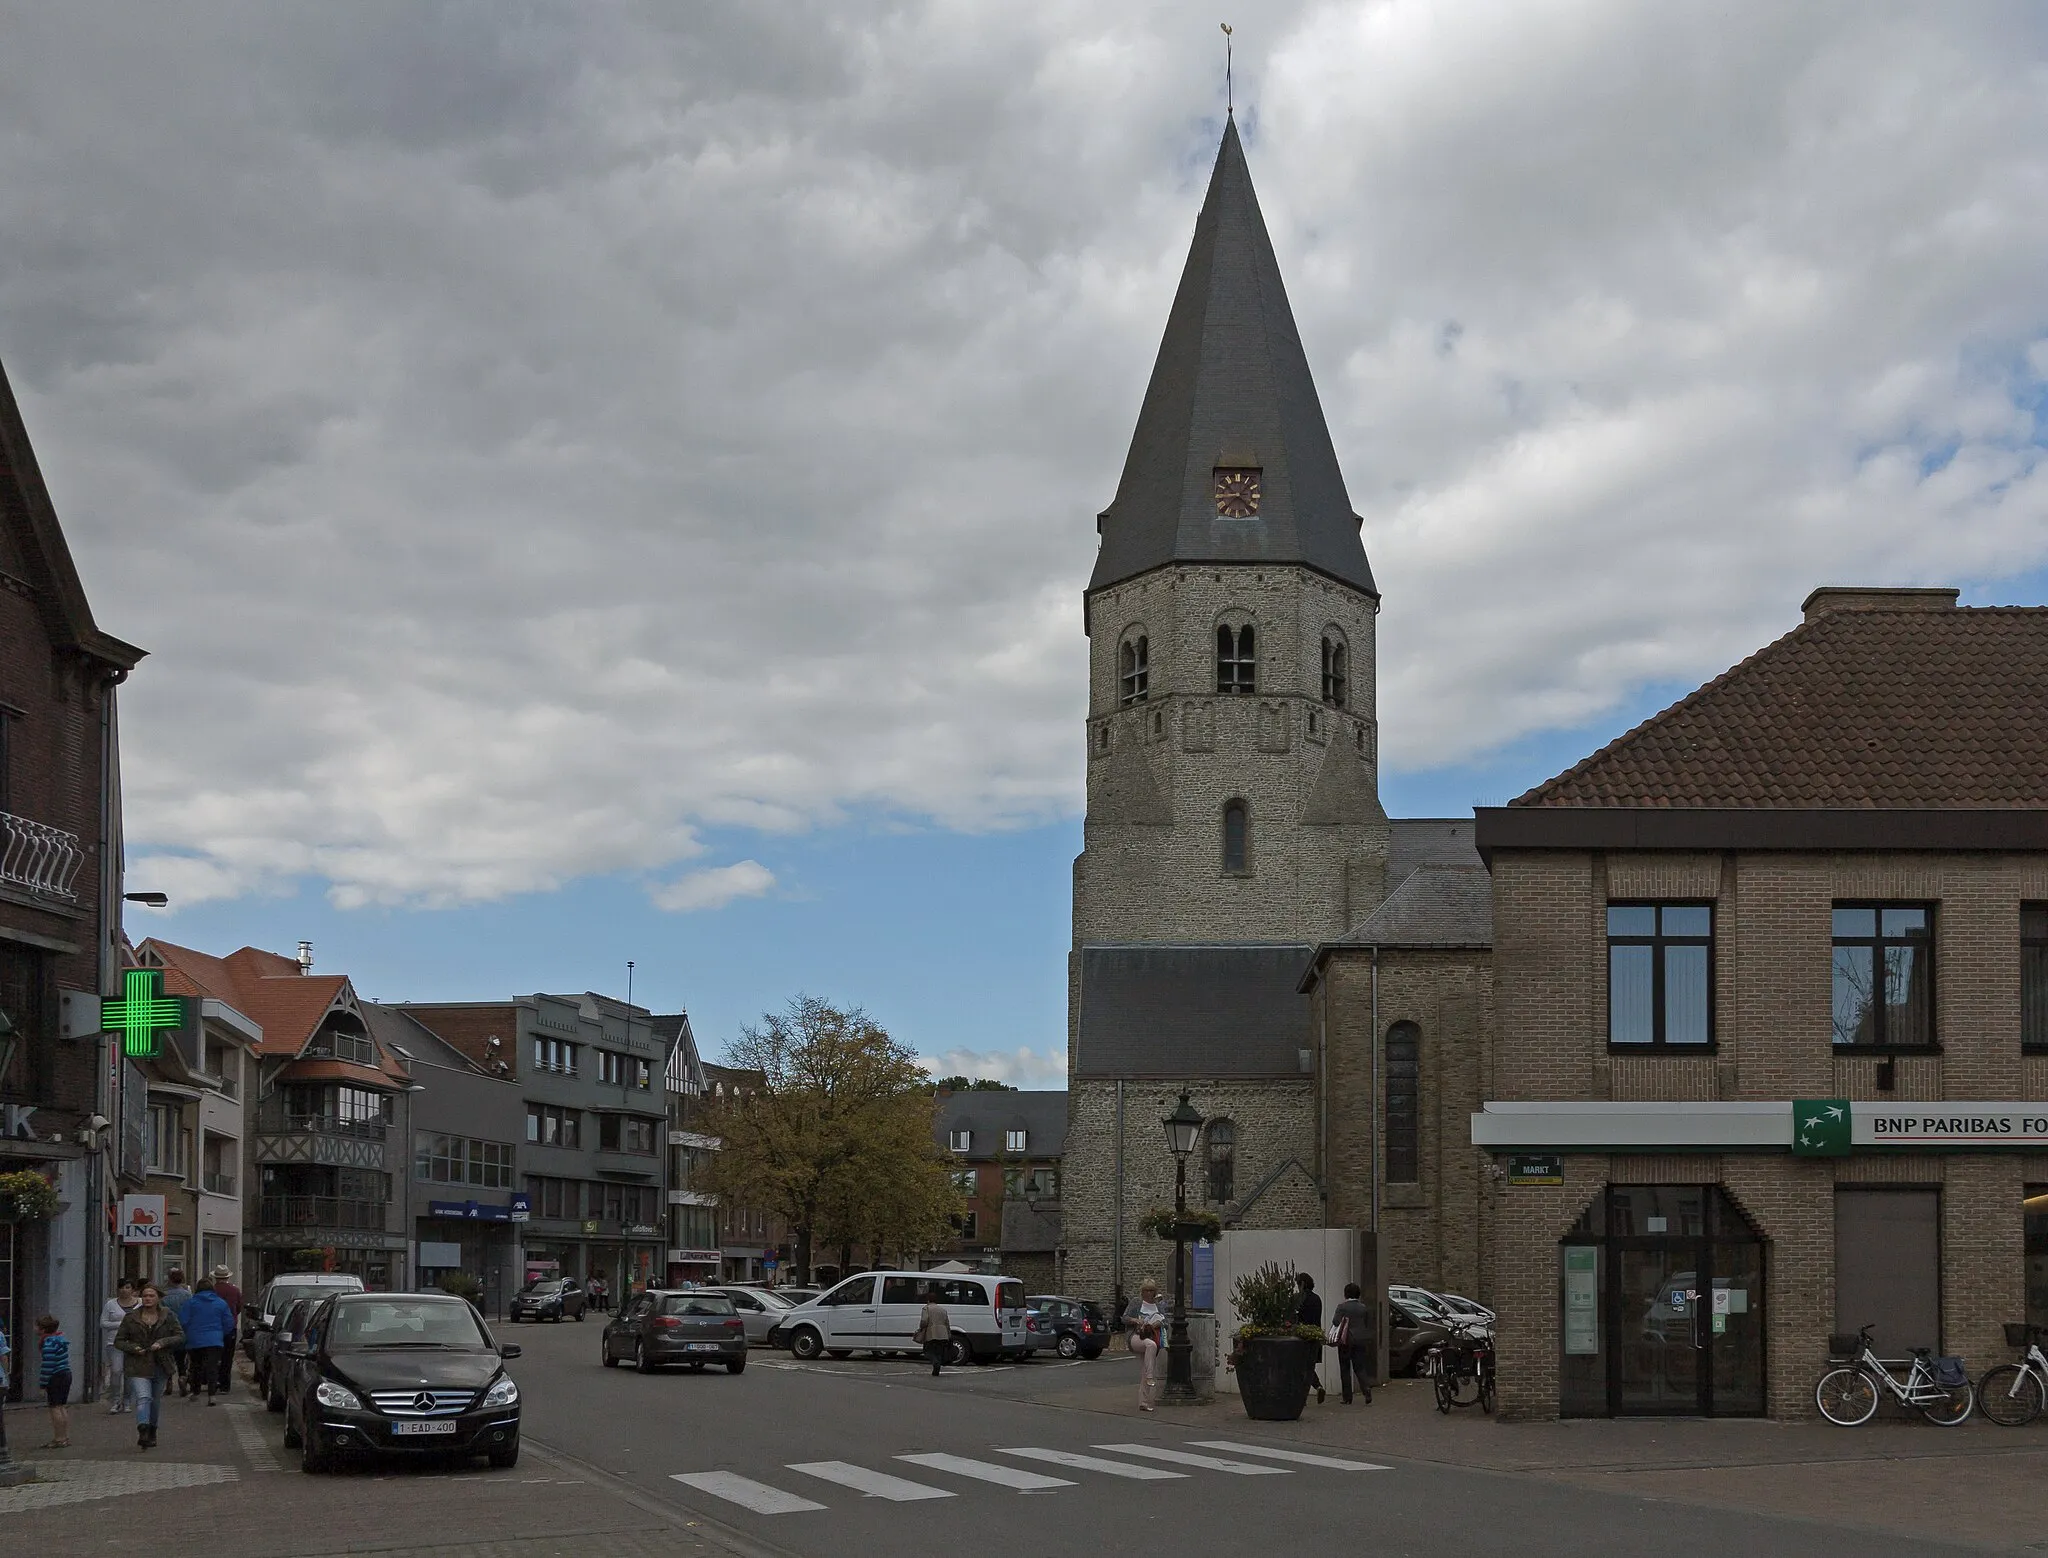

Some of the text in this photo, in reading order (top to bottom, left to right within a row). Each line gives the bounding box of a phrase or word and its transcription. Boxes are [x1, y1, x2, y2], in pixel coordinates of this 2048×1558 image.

[1873, 1118, 1917, 1133] BNP
[1923, 1118, 2011, 1133] PARIBAS
[1523, 1165, 1549, 1174] MARKT
[513, 1201, 527, 1209] AXA
[125, 1225, 162, 1237] ING
[400, 1422, 455, 1433] 1-EAD-400
